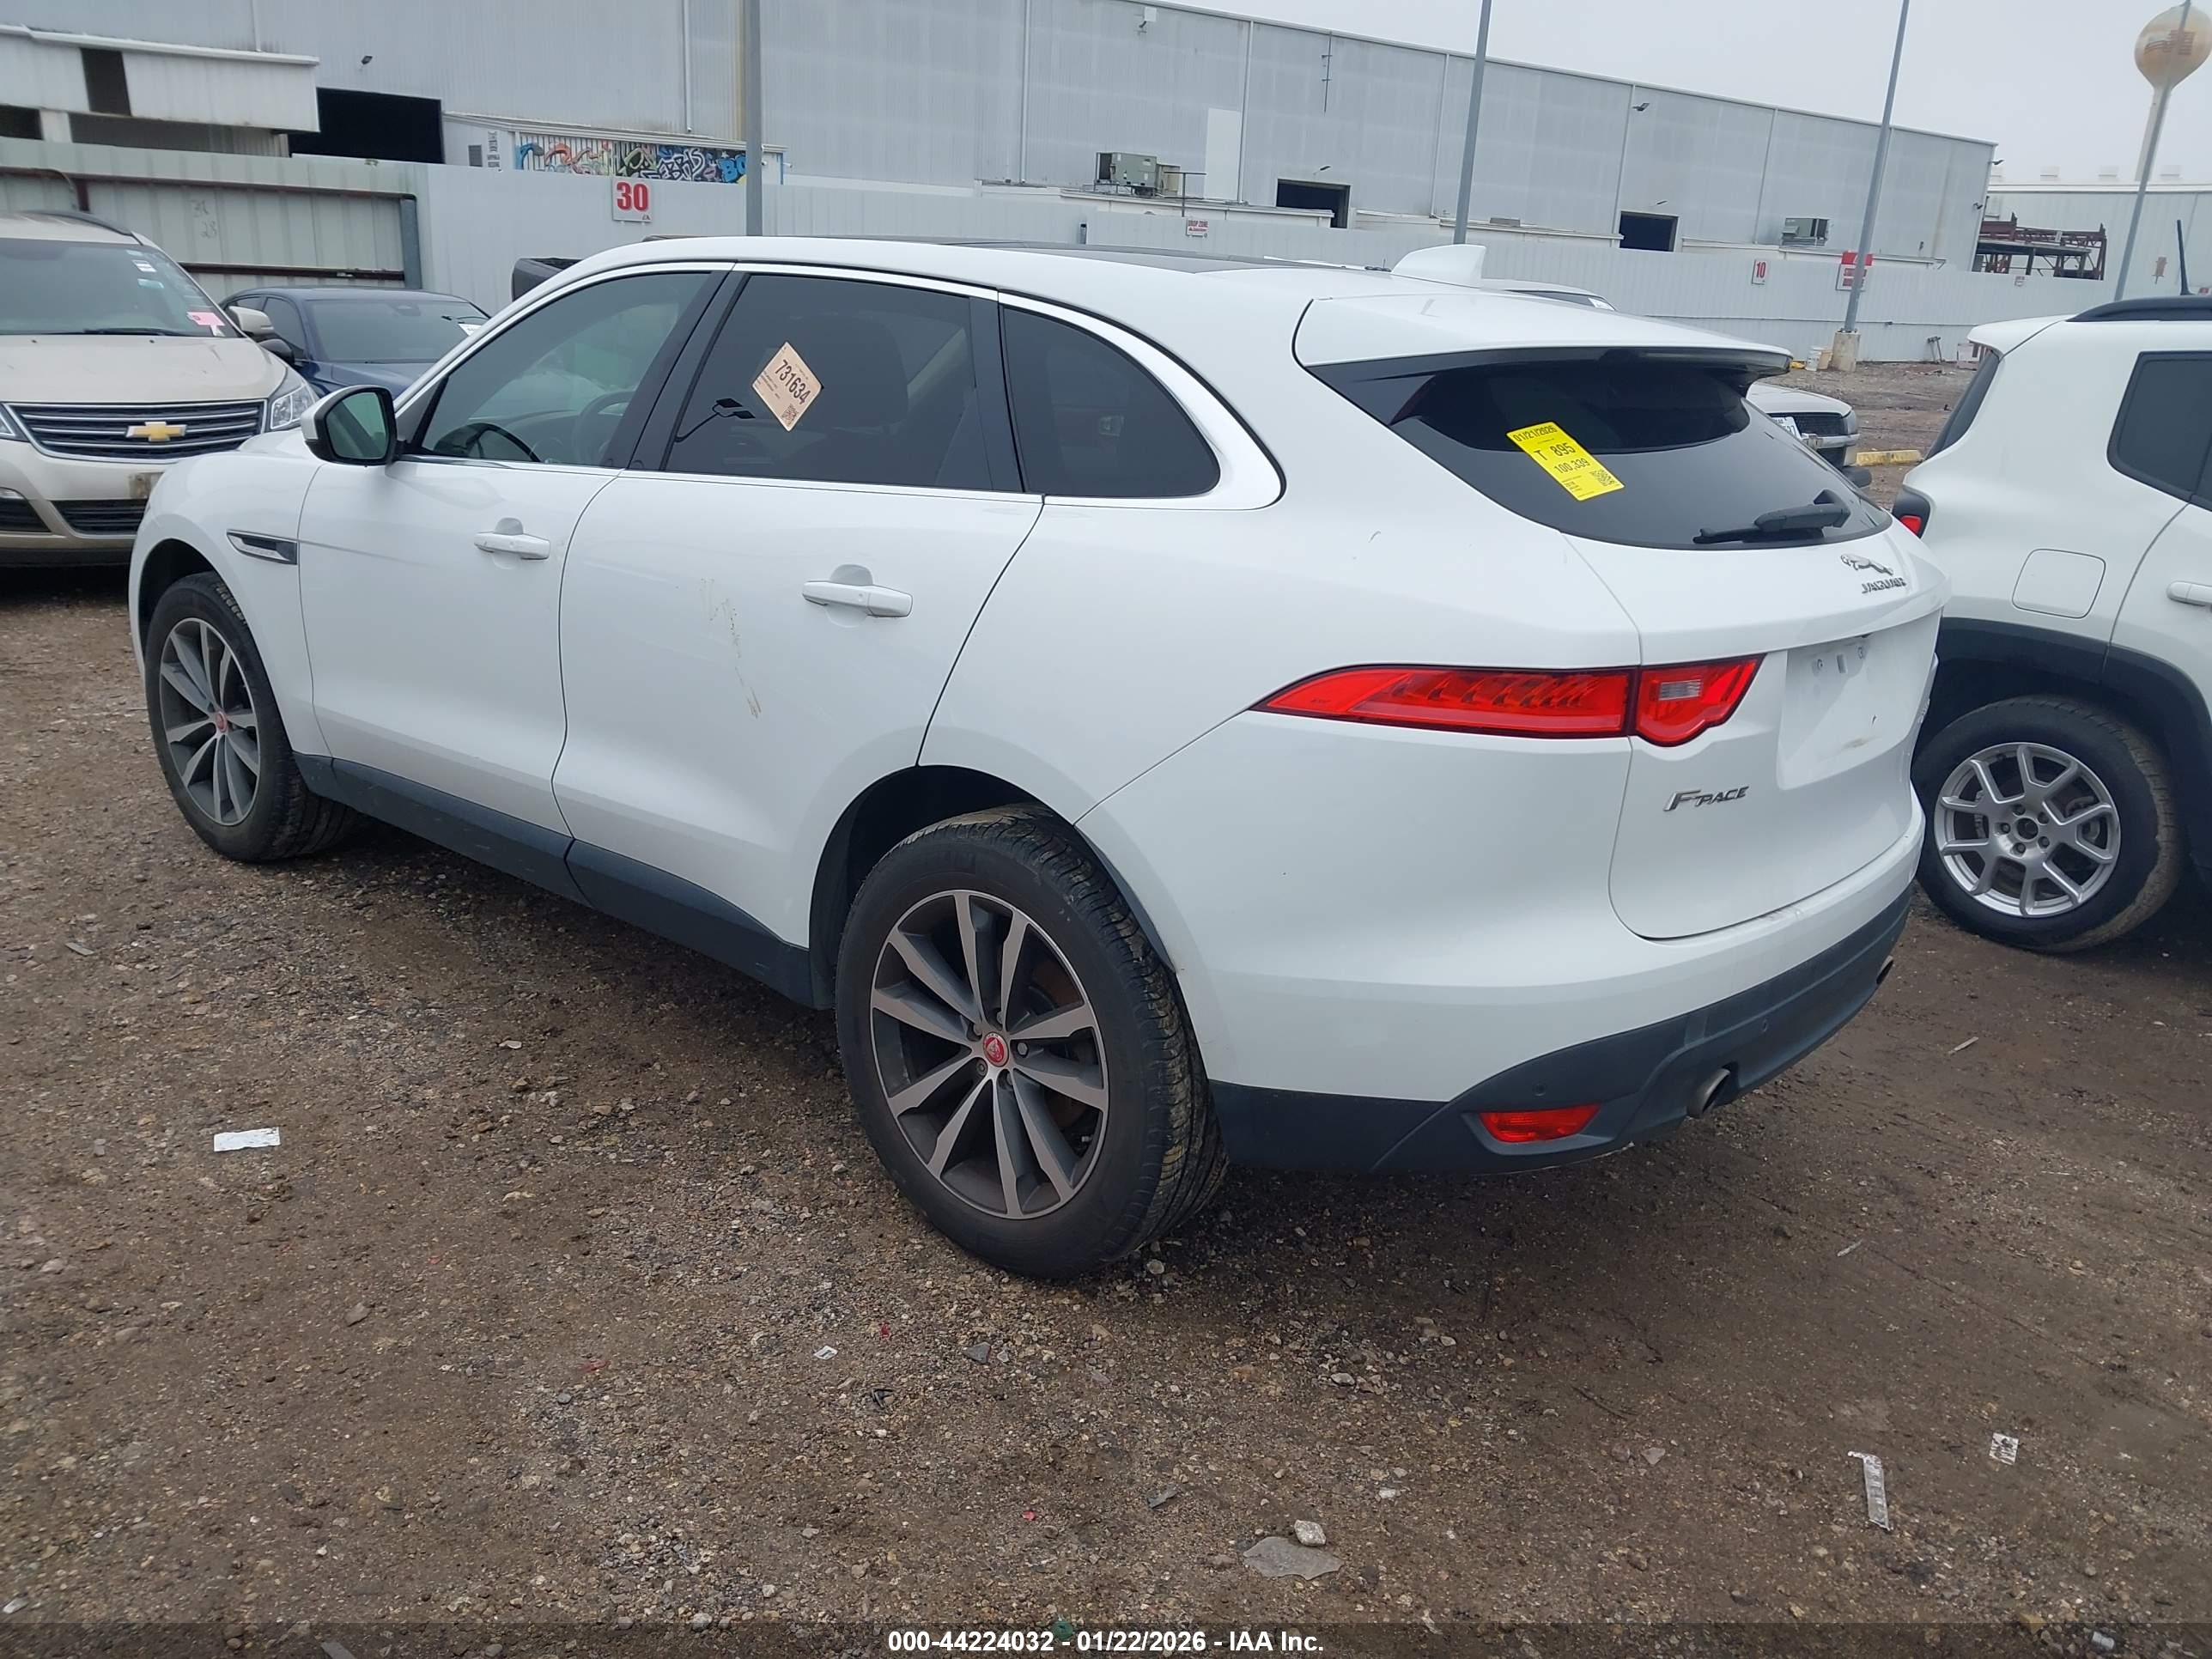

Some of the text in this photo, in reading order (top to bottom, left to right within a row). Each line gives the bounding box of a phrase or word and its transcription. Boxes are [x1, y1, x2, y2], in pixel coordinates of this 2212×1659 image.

[616, 181, 649, 211] 30
[1756, 261, 1766, 278] 10
[775, 359, 811, 404] 731634
[1512, 425, 1558, 442] 01/21/2026
[1550, 442, 1576, 457] 895
[1862, 577, 1906, 593] JAGUAR
